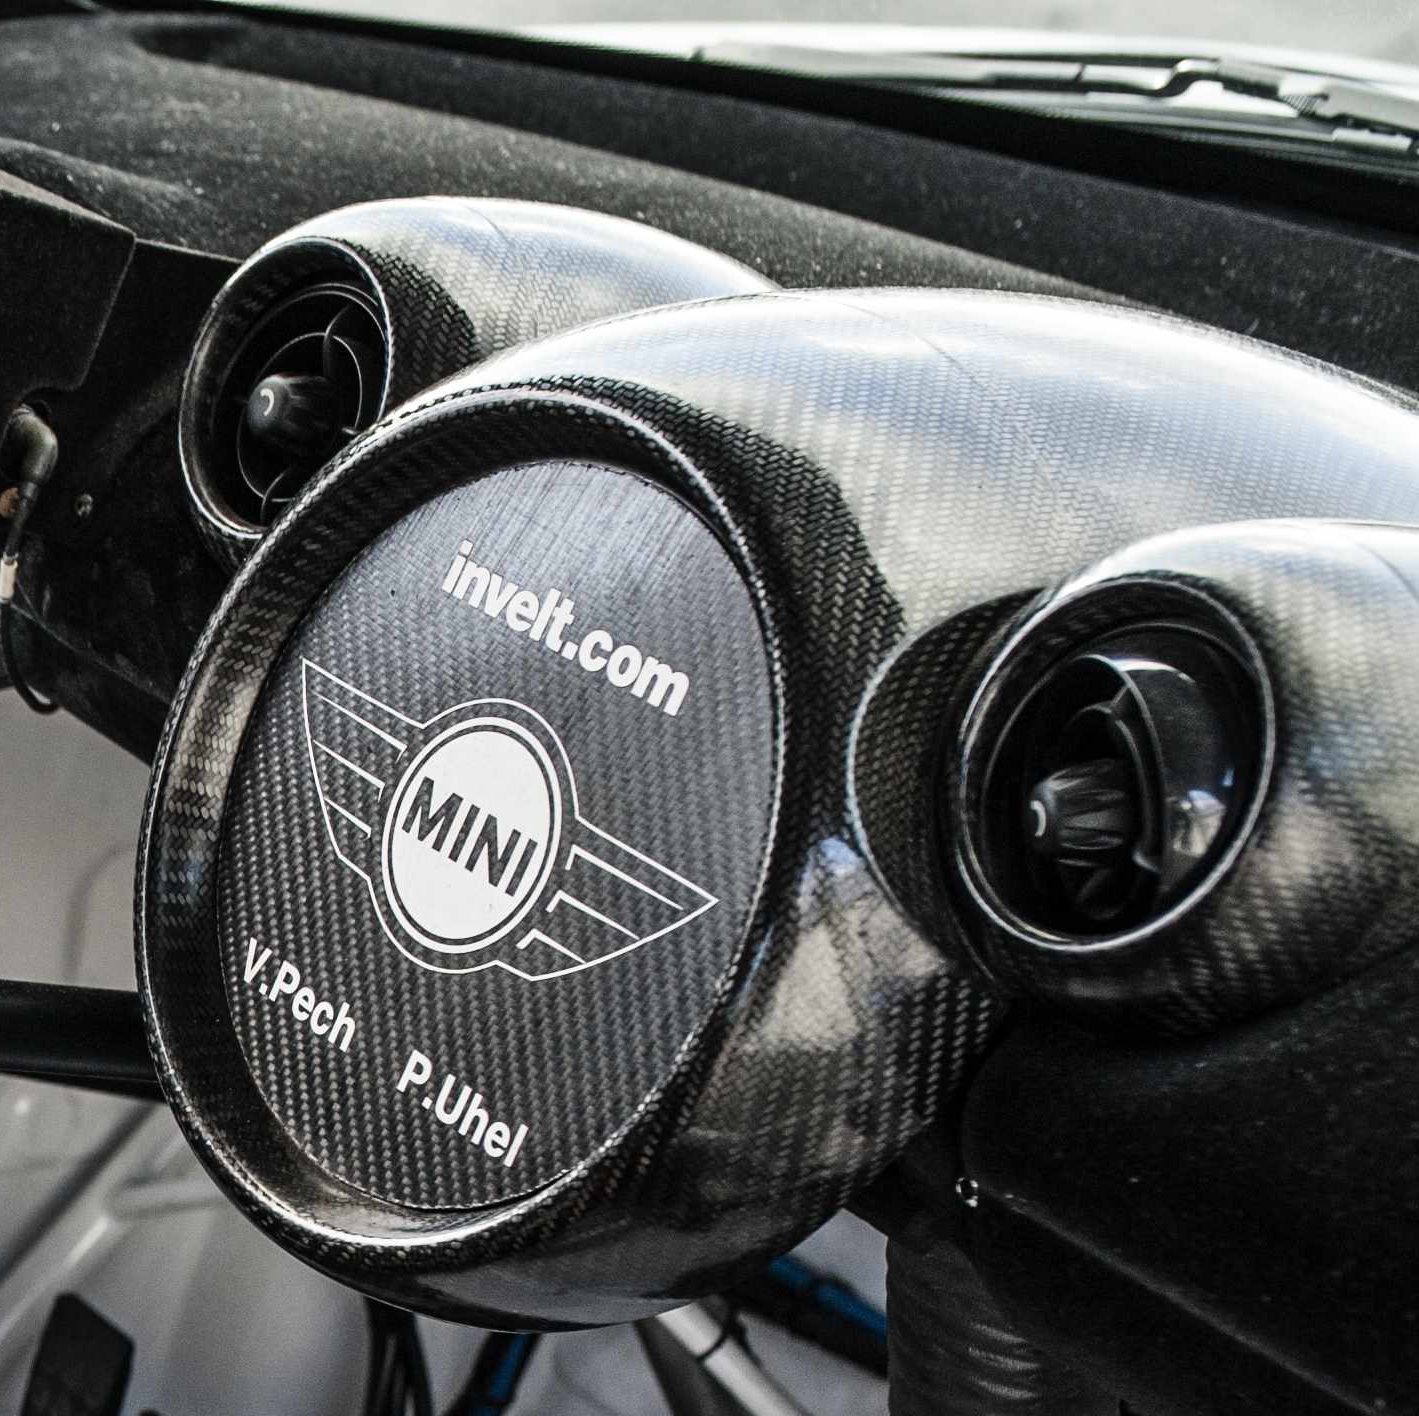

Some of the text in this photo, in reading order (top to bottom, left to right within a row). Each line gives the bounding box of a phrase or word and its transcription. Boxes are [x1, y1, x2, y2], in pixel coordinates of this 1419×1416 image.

[442, 539, 690, 716] invelt.com
[401, 775, 539, 899] MINI
[243, 937, 356, 1053] V.Pech
[396, 1049, 529, 1167] P.Uhel
